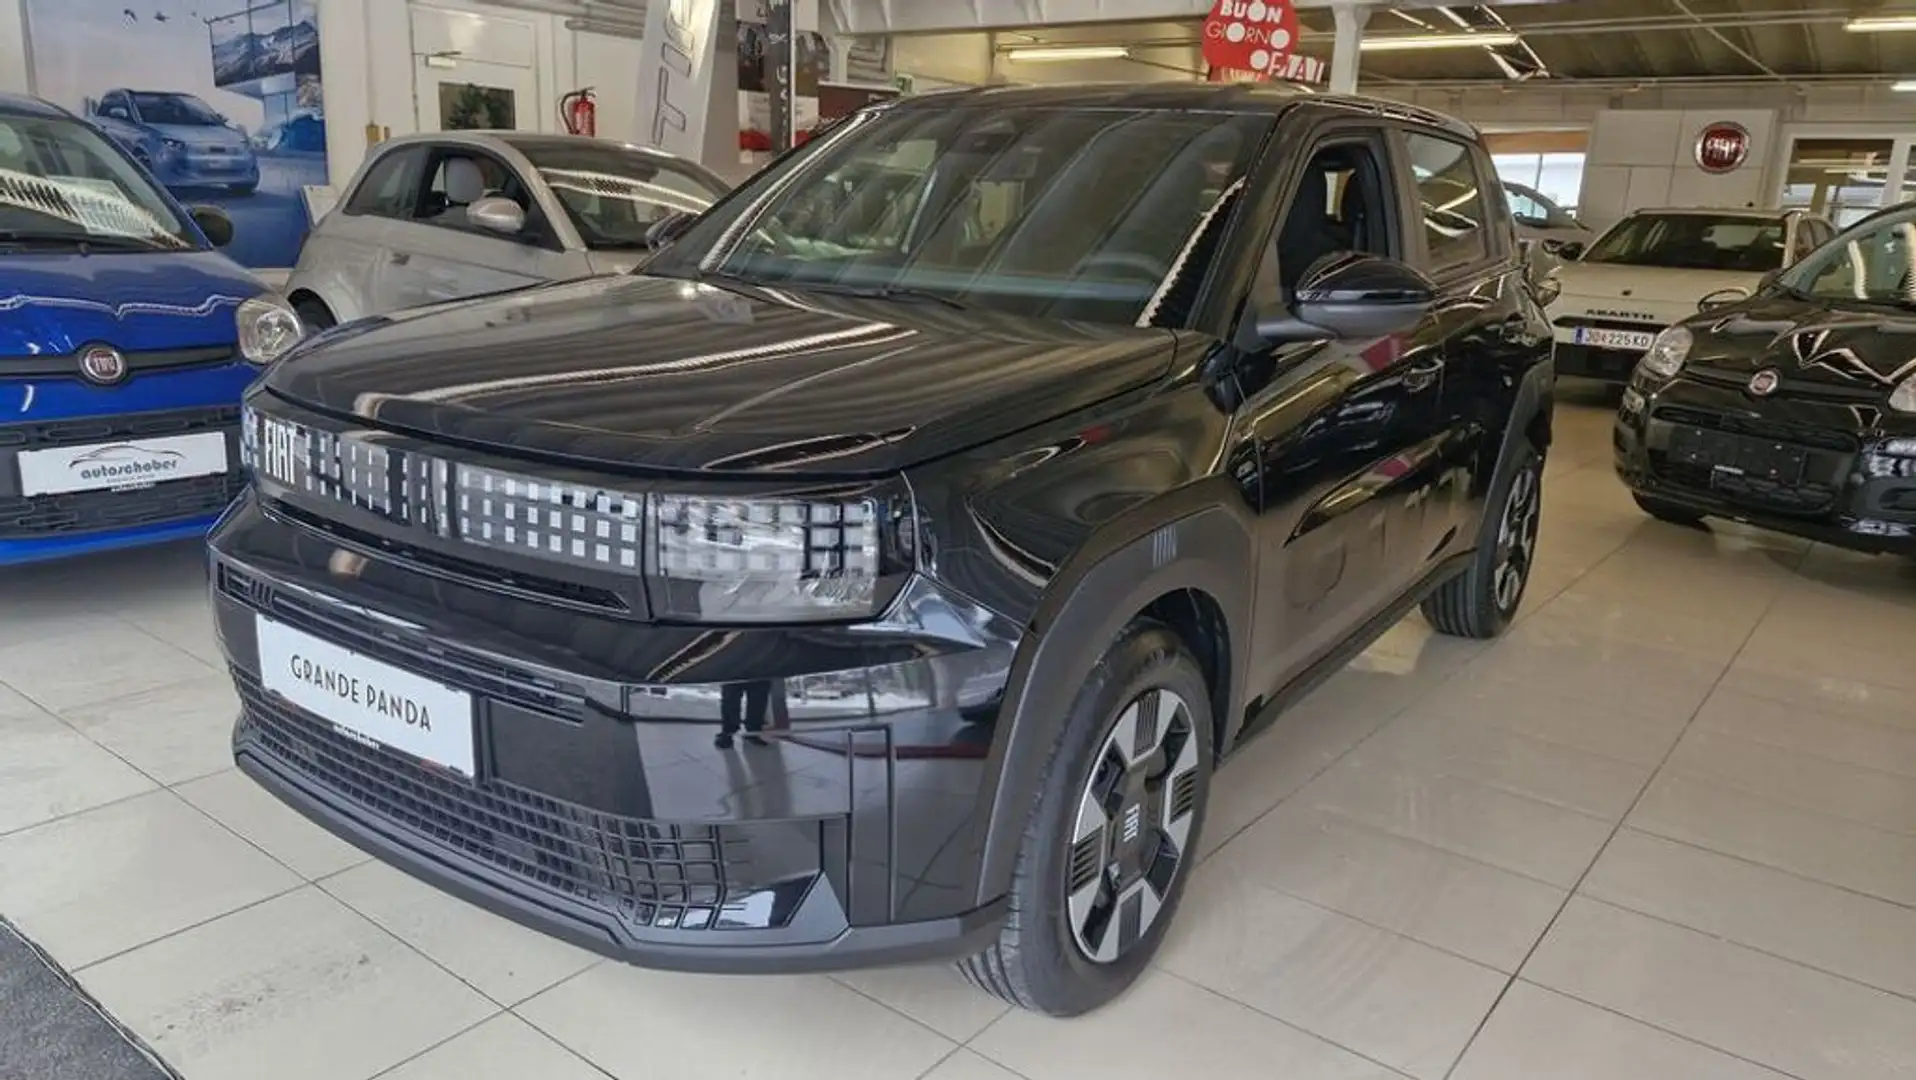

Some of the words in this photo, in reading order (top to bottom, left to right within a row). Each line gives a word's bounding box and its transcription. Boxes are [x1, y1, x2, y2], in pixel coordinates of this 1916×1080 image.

[1220, 0, 1283, 23] BUON
[1205, 20, 1290, 49] GIORNO
[264, 418, 296, 485] FIAT
[80, 459, 178, 480] autoschober
[290, 653, 360, 704] GRANDE
[365, 683, 431, 733] PANDA
[1123, 802, 1141, 843] FIAT
